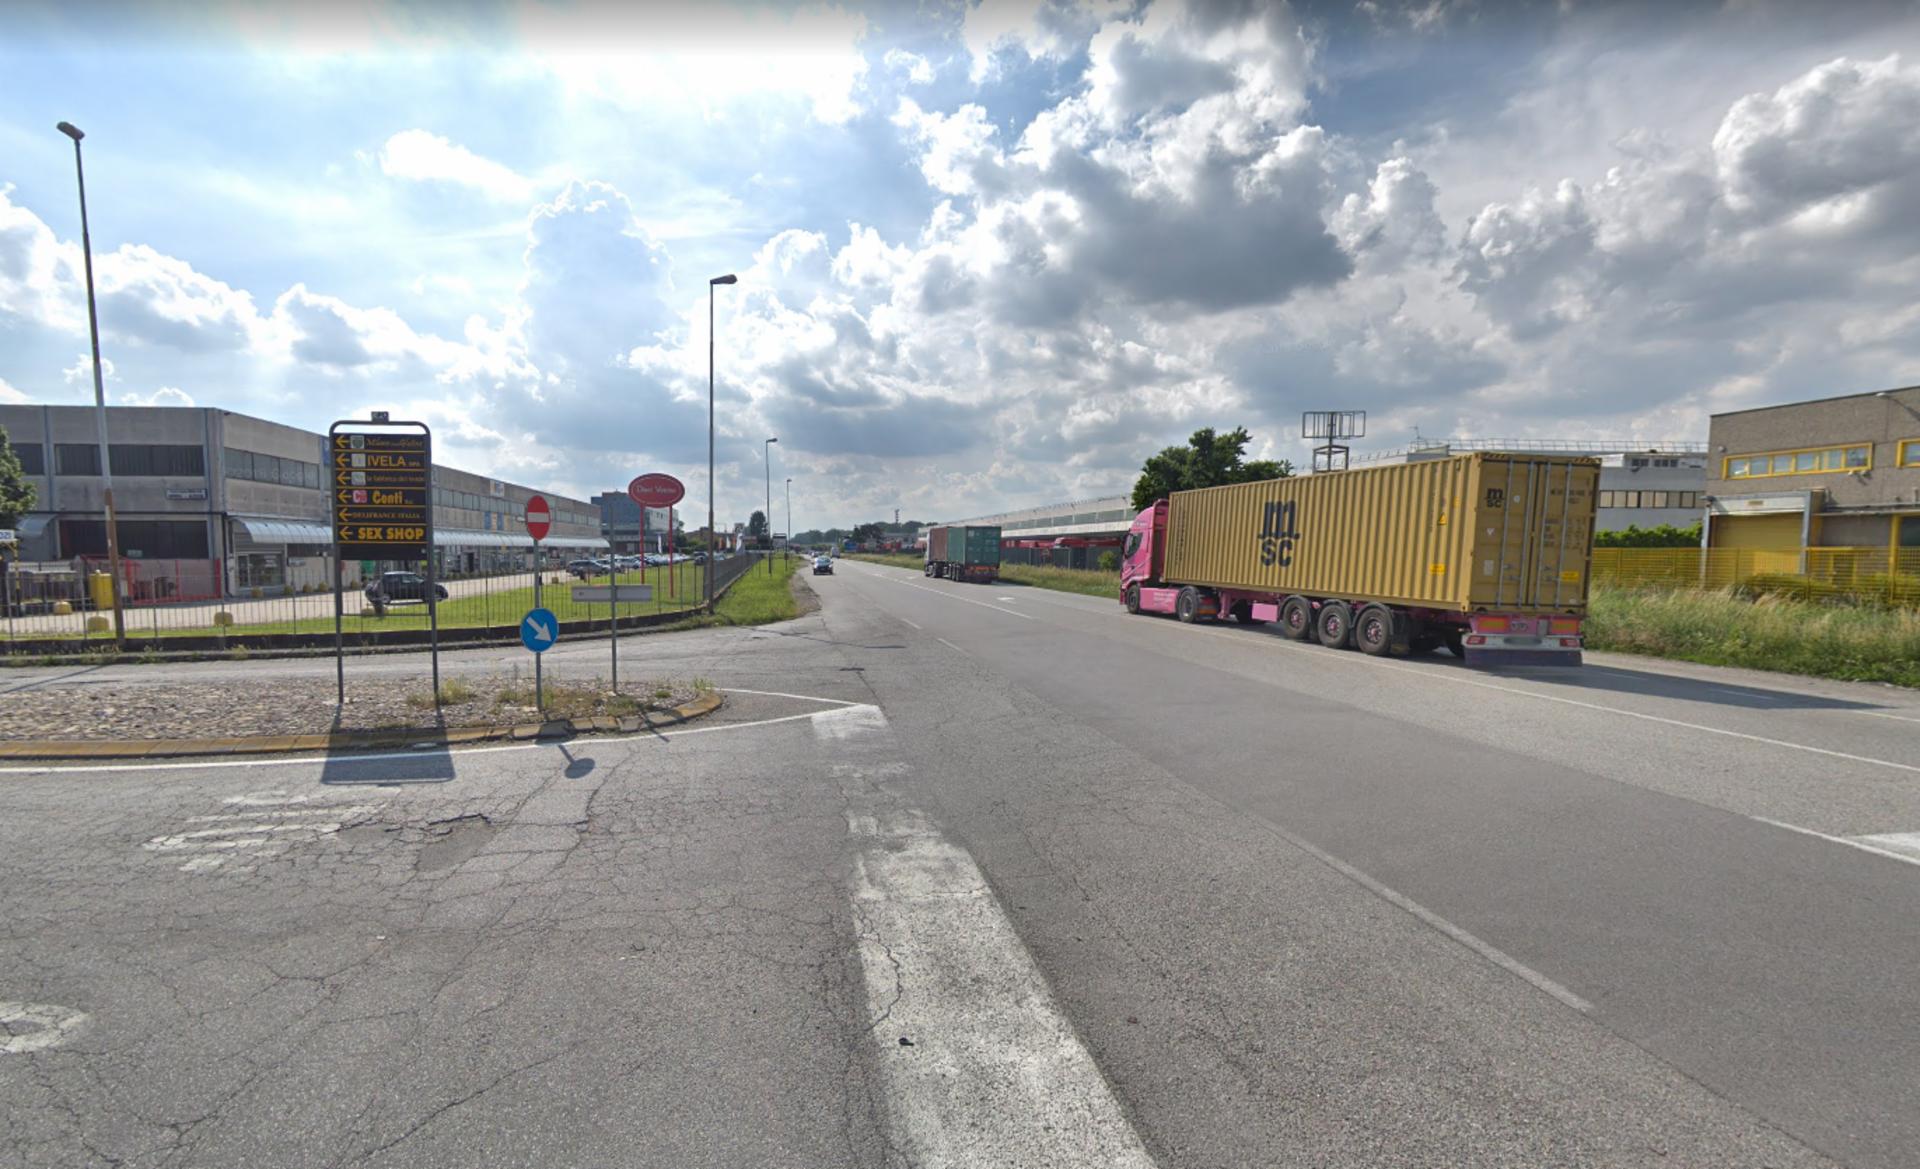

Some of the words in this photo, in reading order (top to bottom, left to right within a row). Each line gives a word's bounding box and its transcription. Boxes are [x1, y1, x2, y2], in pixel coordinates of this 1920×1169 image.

[367, 455, 406, 467] IVELA
[372, 490, 403, 504] Conti
[358, 528, 382, 540] SEX
[386, 528, 424, 540] SHOP
